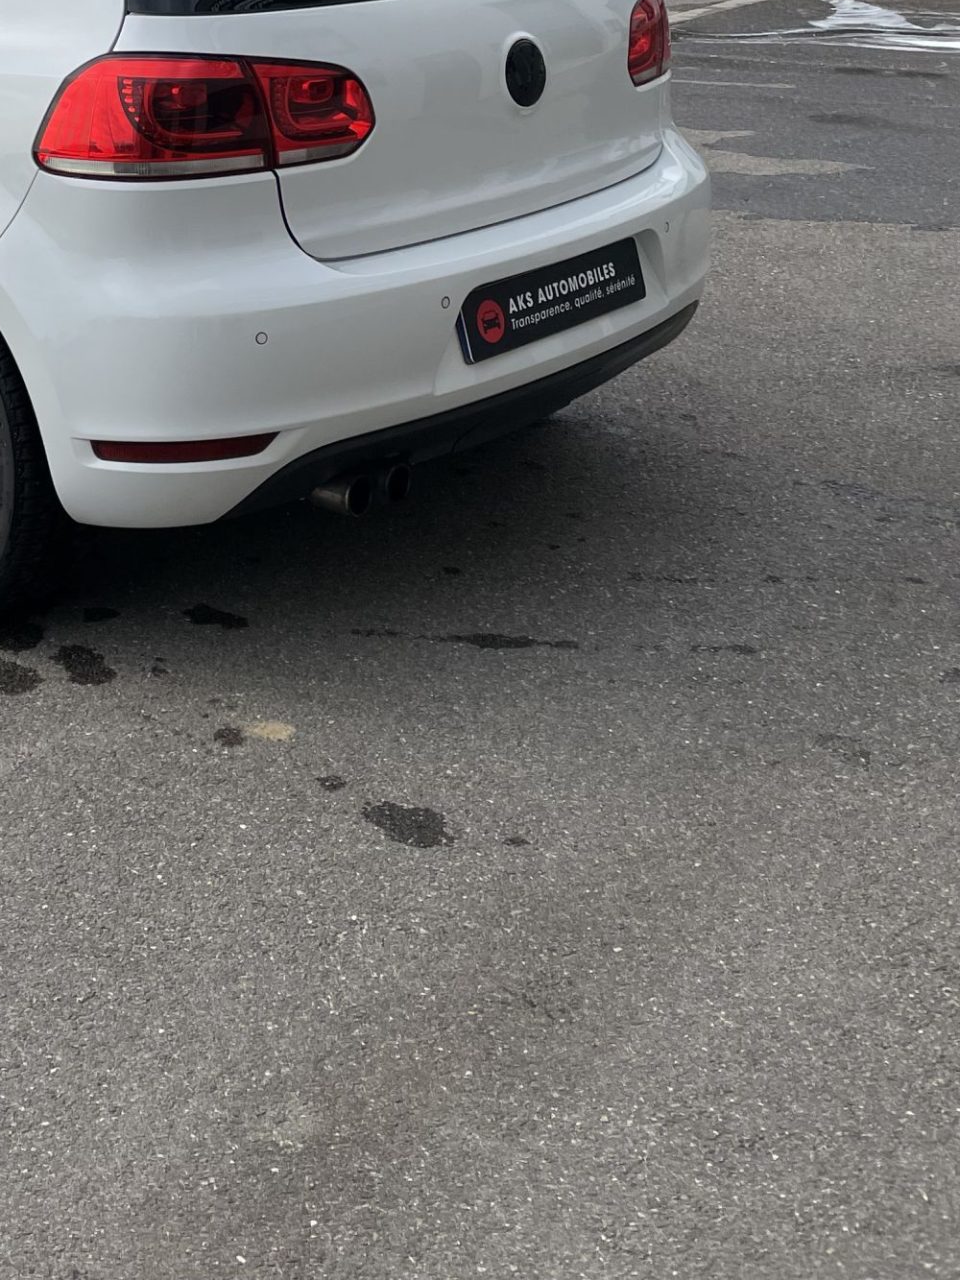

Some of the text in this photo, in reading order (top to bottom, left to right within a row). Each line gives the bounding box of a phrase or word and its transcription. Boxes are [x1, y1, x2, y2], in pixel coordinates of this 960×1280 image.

[509, 262, 616, 314] AKS AUTOMOBILES
[511, 274, 636, 330] Transparence, qualité, sérénité
